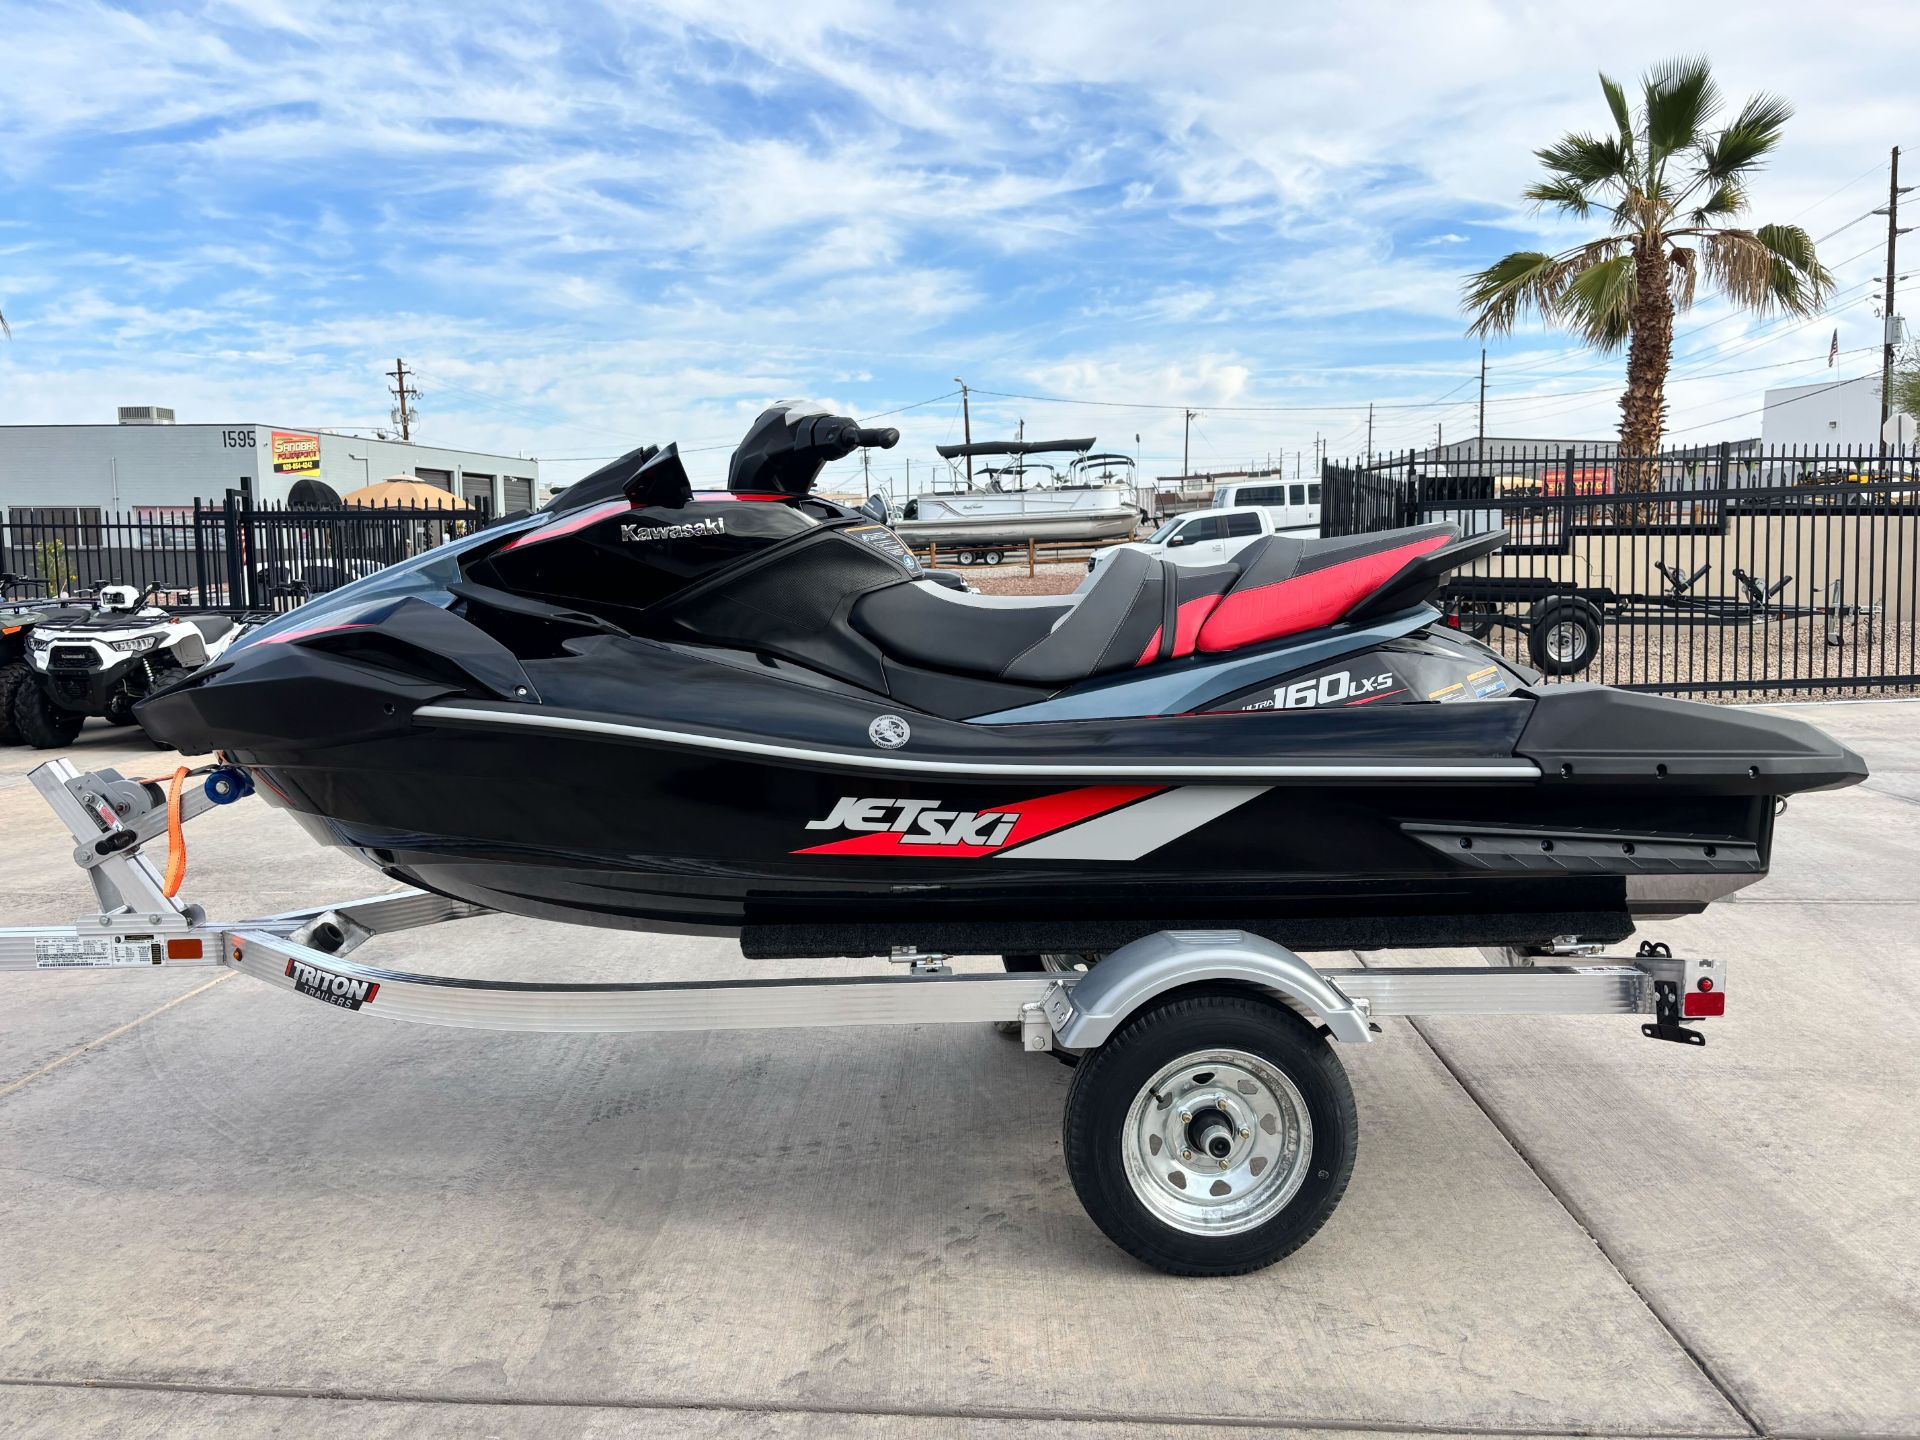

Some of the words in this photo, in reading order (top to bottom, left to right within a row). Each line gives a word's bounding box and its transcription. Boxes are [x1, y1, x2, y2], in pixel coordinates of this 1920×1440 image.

[222, 430, 256, 448] 1595
[620, 517, 725, 541] Kawasaki
[1273, 670, 1350, 709] 160
[1349, 672, 1393, 696] LX-S
[804, 797, 942, 832] JET
[293, 961, 369, 1001] TRITON
[303, 986, 353, 1008] TRAILERS
